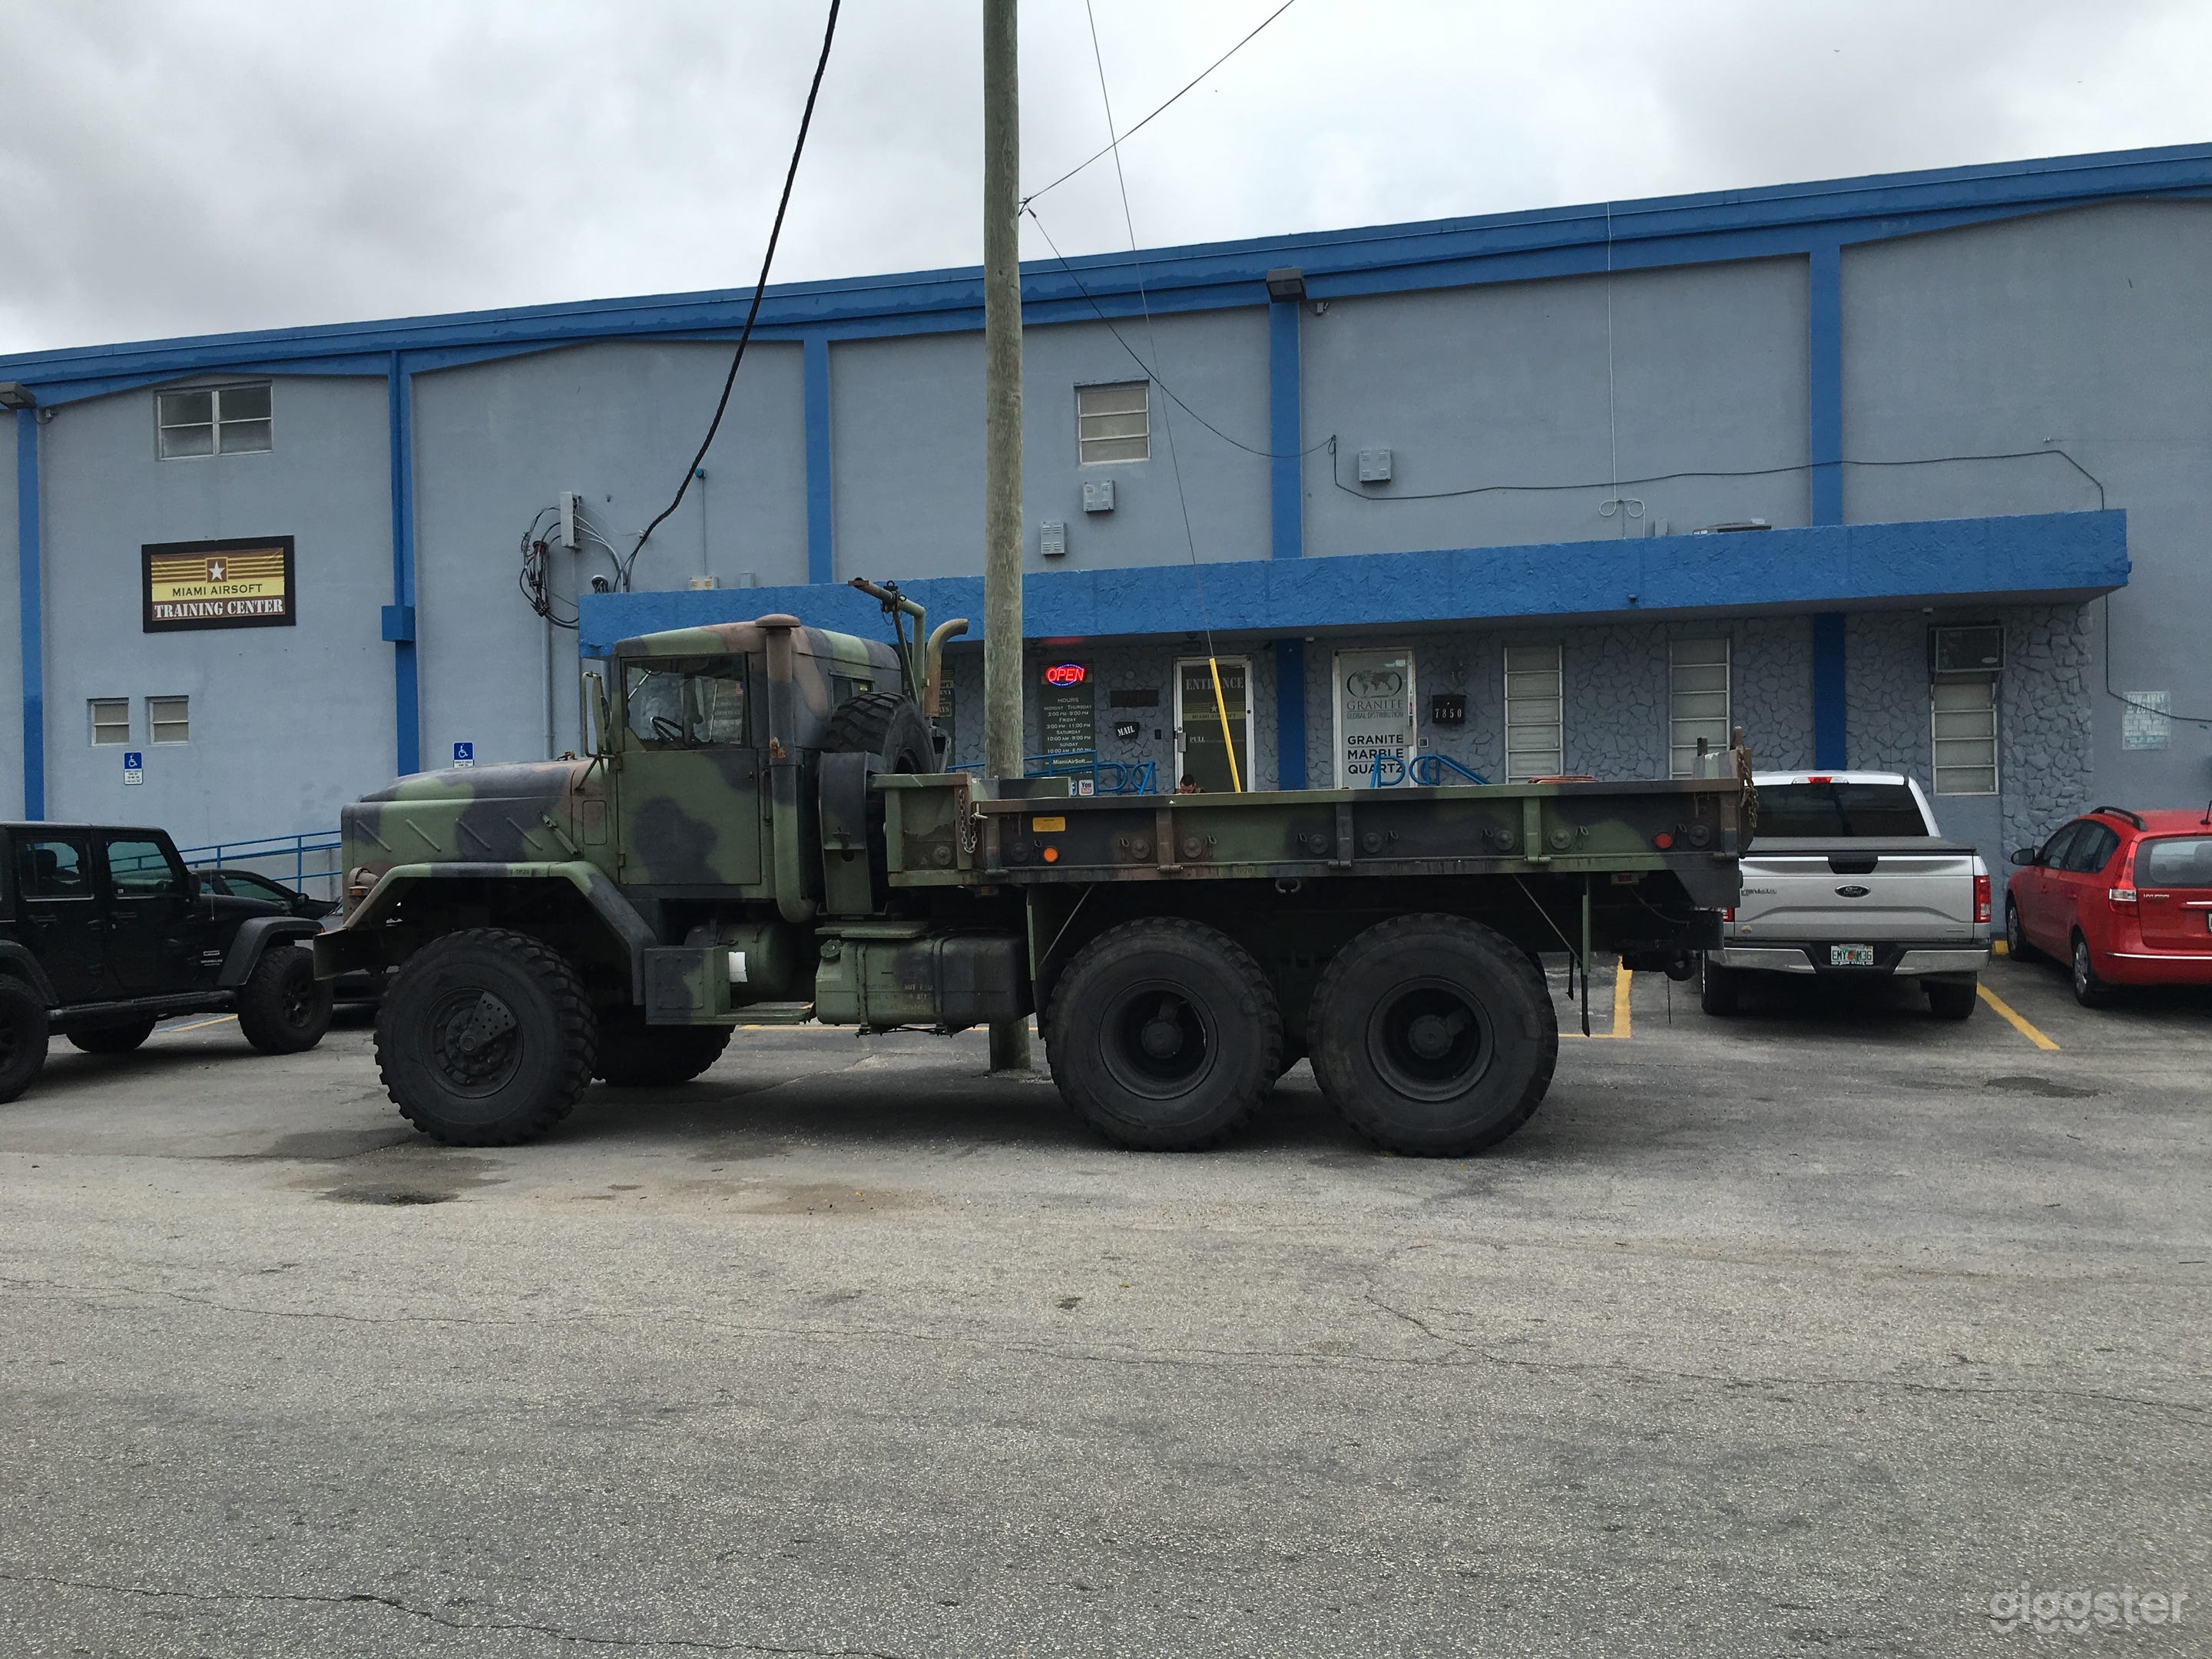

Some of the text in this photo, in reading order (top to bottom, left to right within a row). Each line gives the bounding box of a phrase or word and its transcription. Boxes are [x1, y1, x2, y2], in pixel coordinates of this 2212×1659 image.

[172, 584, 263, 597] MIAMI AIRSOFT
[154, 598, 283, 618] TRAINING CENTER
[1047, 667, 1085, 682] OPEN
[1185, 677, 1244, 690] ENTRNCE
[1346, 699, 1402, 710] GRANITE
[1435, 708, 1462, 718] 7850
[1117, 725, 1135, 737] MAIL
[1347, 734, 1403, 745] GRANITE
[1832, 950, 1873, 960] EMY M36
